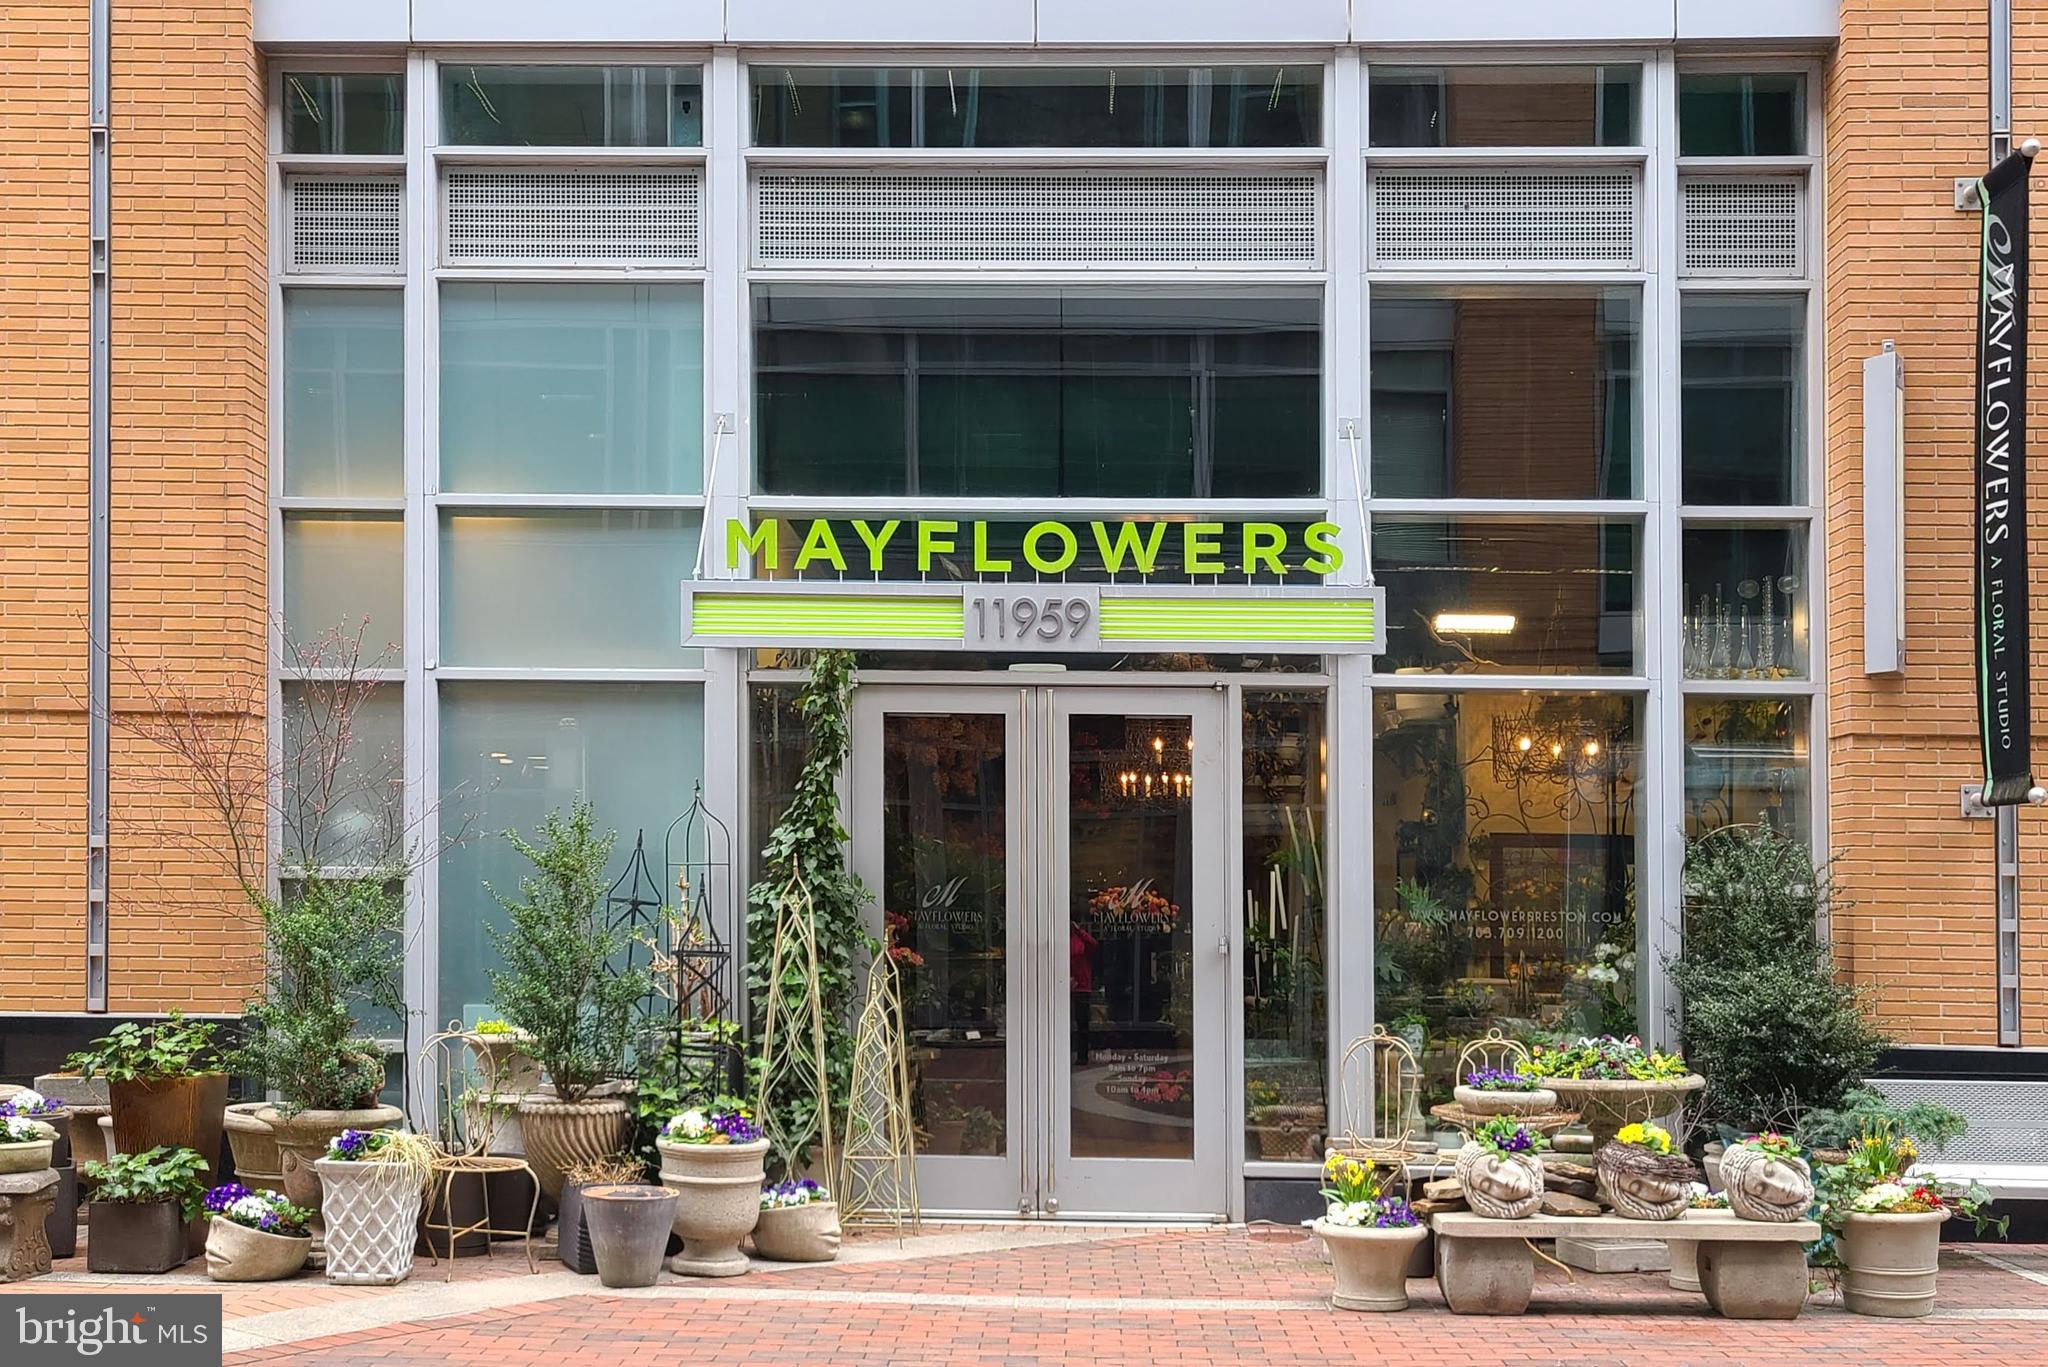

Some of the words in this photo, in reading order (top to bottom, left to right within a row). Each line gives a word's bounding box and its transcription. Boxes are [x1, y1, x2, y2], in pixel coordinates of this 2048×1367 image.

[1985, 263, 2015, 545] MAYFLOWERS
[726, 519, 1344, 575] MAYFLOWERS
[972, 596, 1092, 640] 11959
[1991, 579, 2006, 660] FLORAL
[1995, 670, 2012, 749] STUDIO
[908, 910, 983, 922] MAYFLOWERS
[1095, 1052, 1127, 1062] Monday
[1133, 1052, 1169, 1063] Saturday
